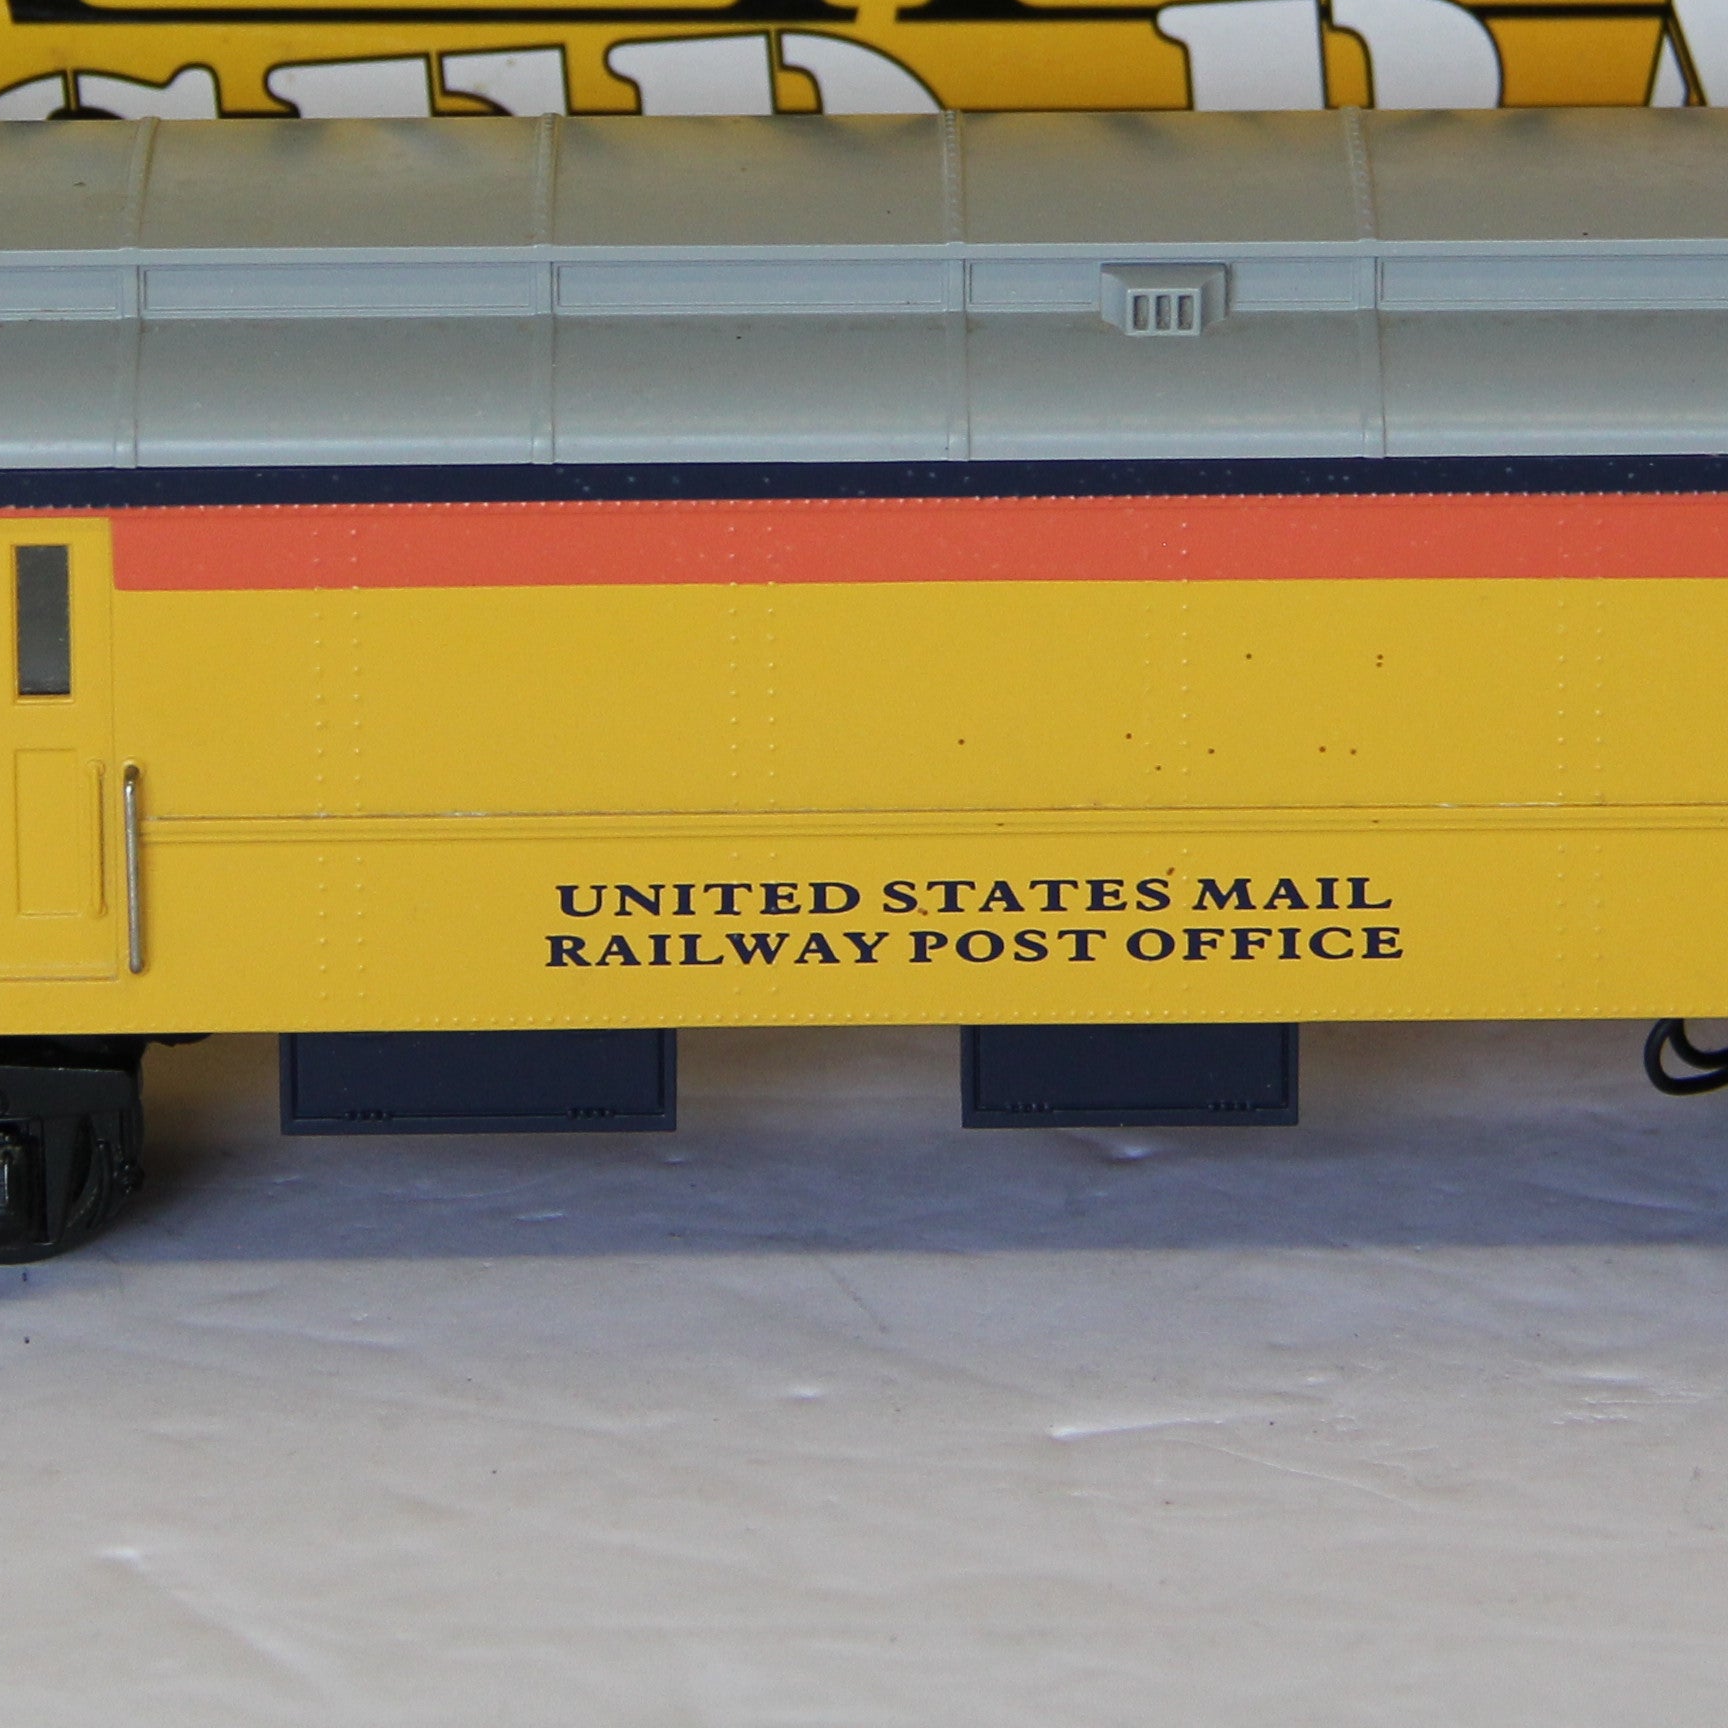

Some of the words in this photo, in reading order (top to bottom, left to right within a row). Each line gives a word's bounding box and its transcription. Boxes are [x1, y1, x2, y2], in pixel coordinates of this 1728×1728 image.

[556, 881, 861, 917] UNITED
[883, 878, 1172, 914] STATES
[1192, 877, 1393, 910] MAIL
[545, 931, 890, 967] RAILWAY
[908, 928, 1107, 964] POST
[1126, 926, 1404, 962] OFFICE
